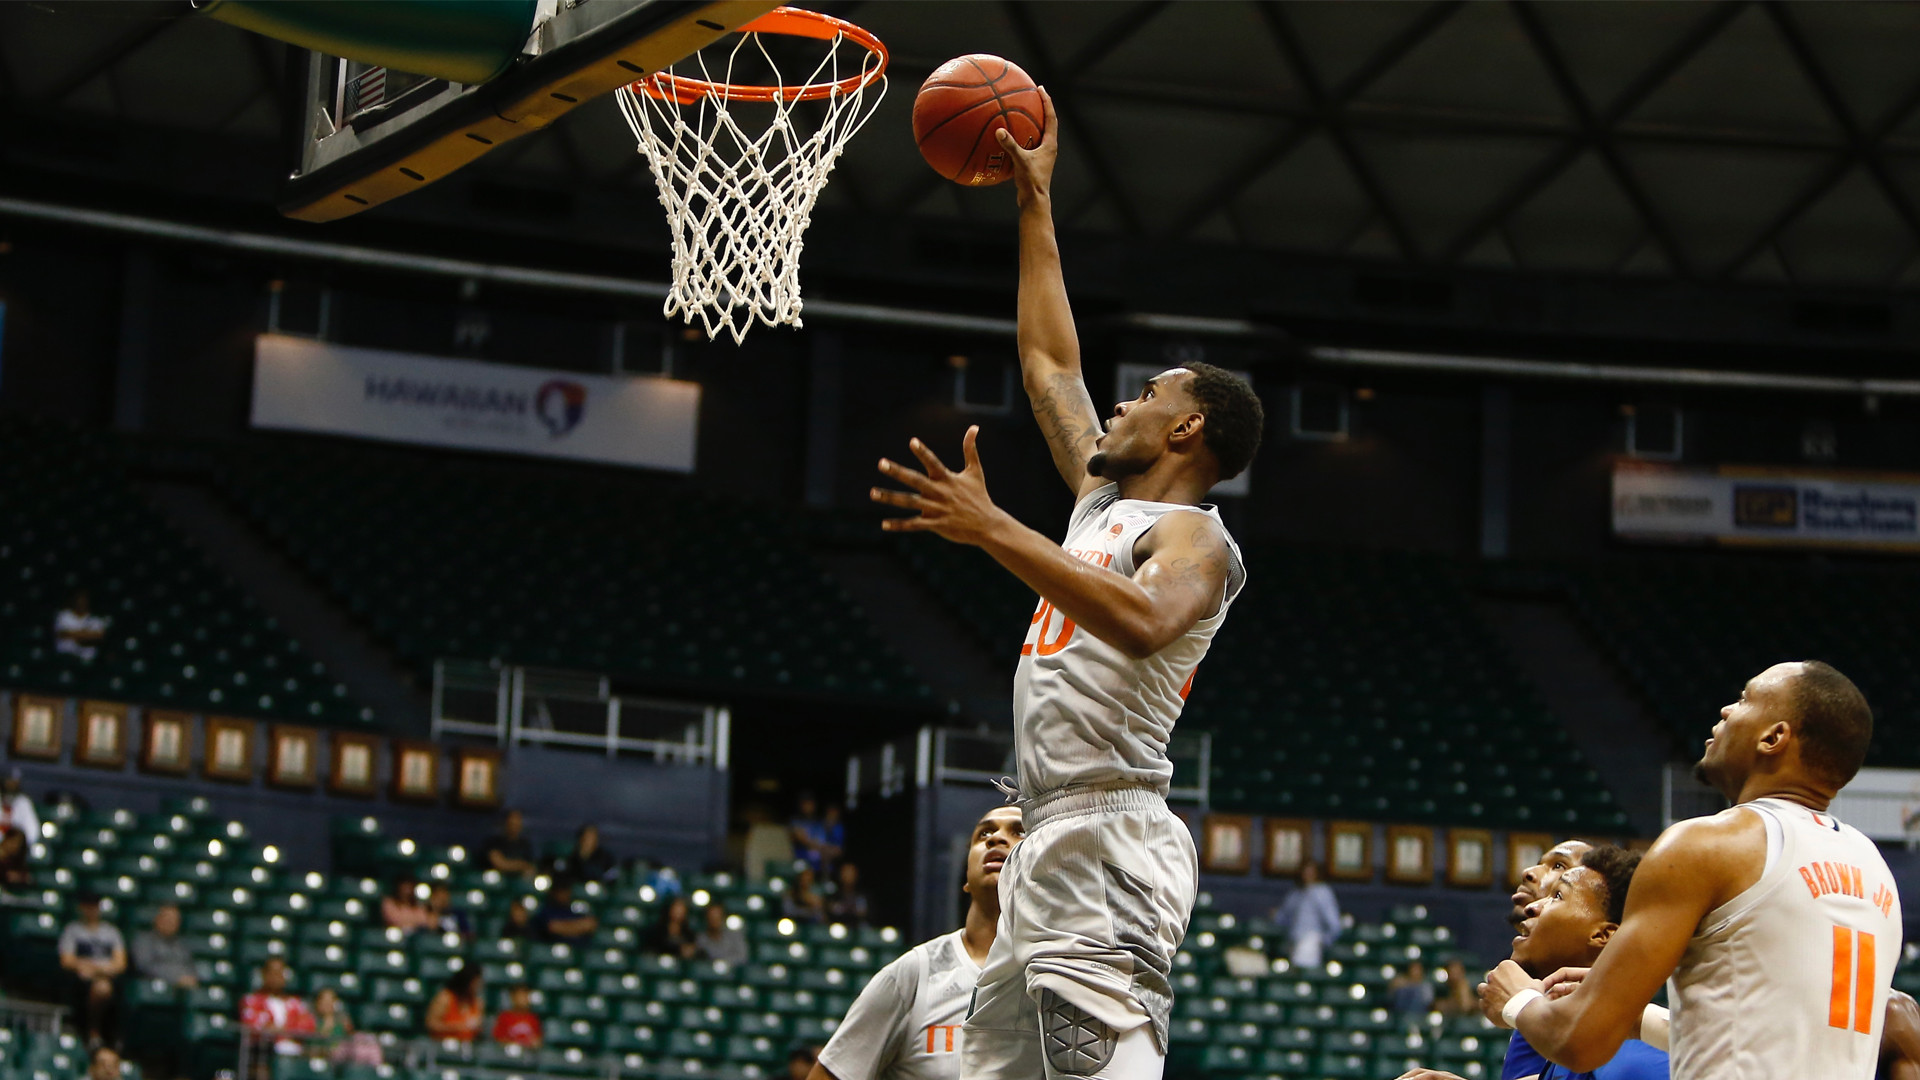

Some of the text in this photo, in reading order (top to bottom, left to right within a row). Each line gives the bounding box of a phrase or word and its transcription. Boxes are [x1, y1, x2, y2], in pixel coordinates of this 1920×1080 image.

[1798, 861, 1894, 919] BROWN JR
[1828, 925, 1876, 1035] 11
